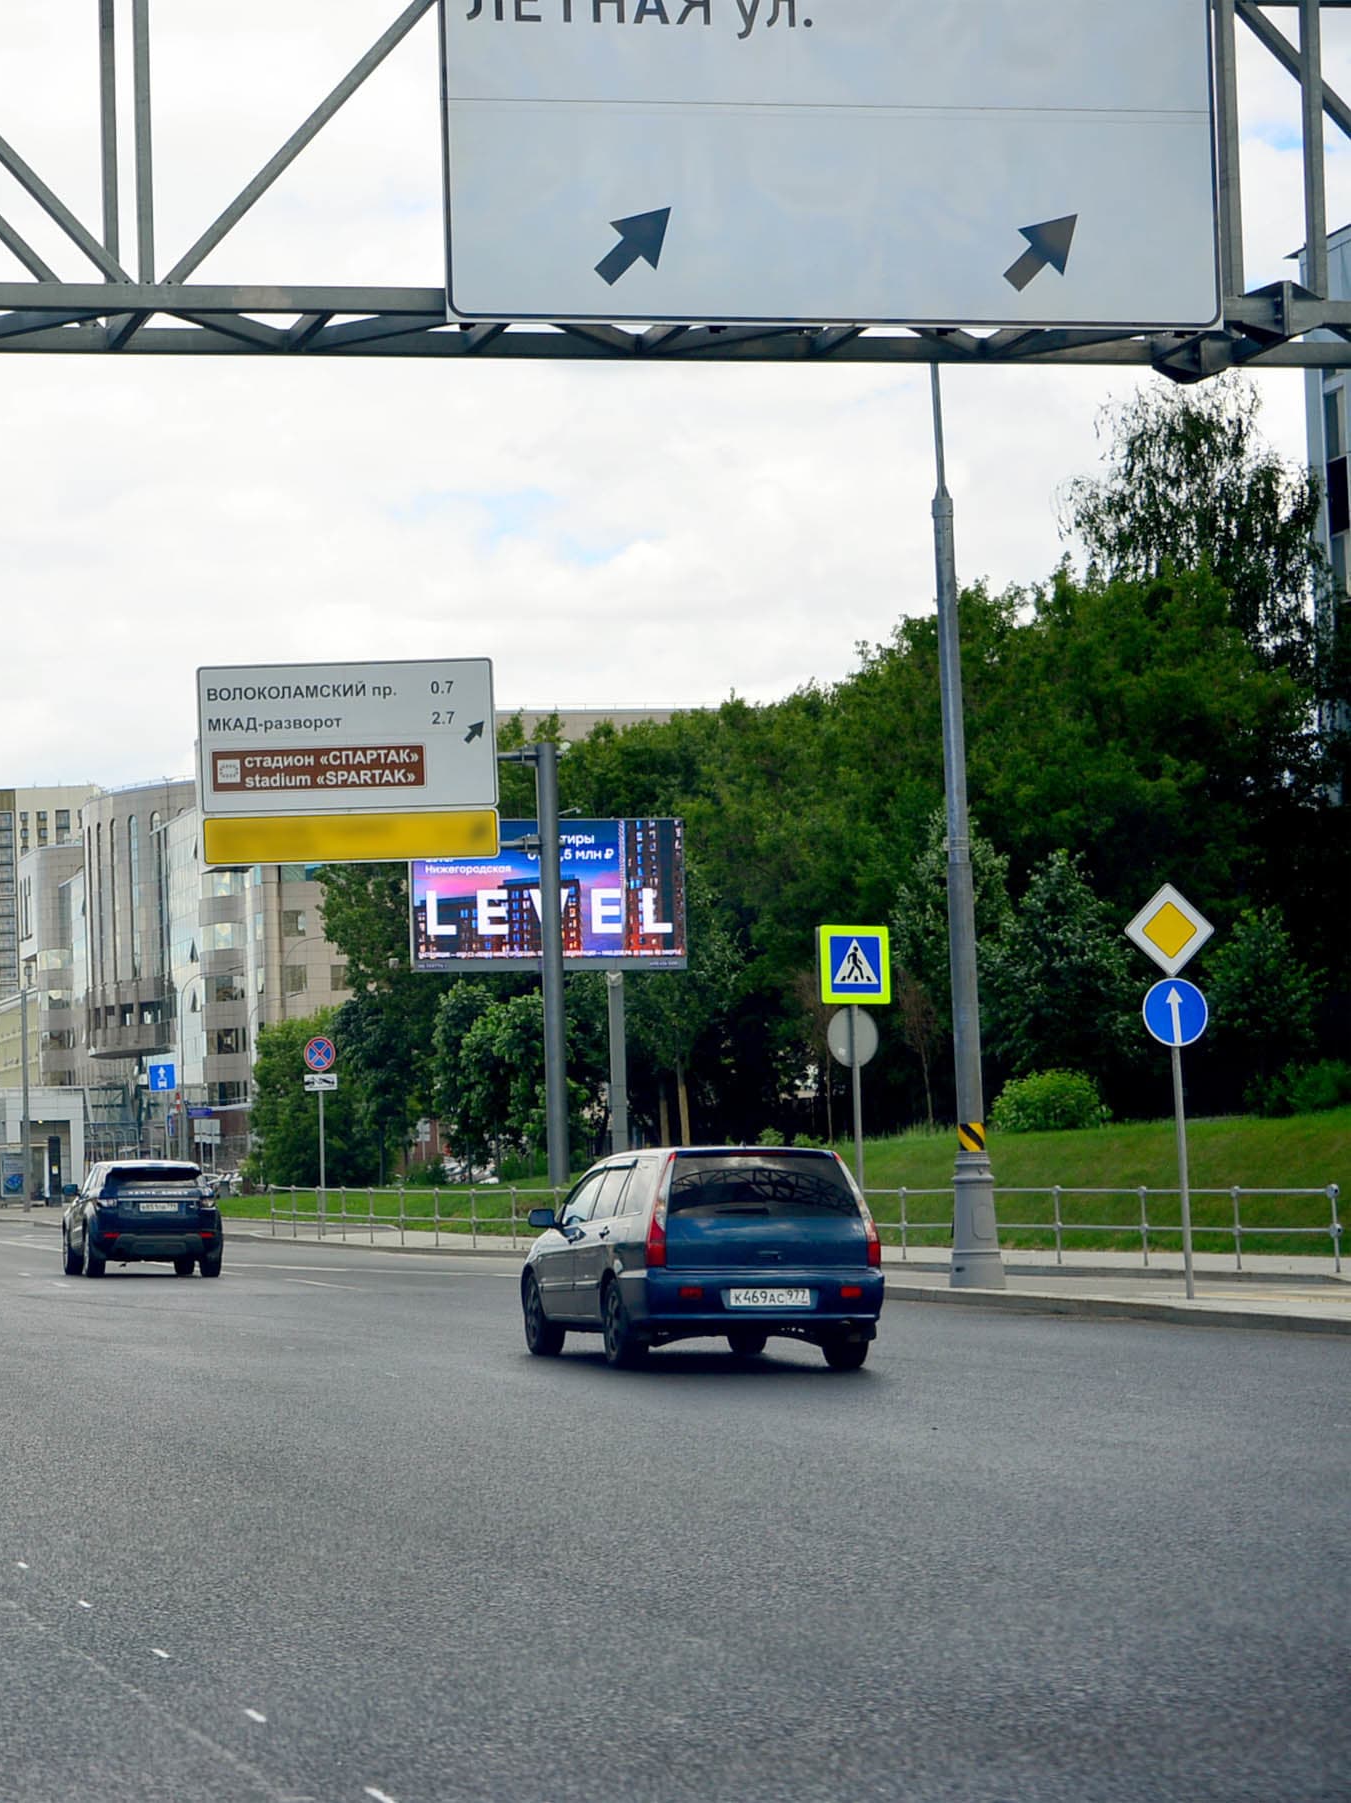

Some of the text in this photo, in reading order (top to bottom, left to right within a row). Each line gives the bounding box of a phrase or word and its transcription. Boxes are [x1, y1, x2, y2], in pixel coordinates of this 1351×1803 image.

[736, 0, 813, 39] ул.
[207, 681, 454, 701] ВОЛОКОЛАМСКИЙ пр. 0.7
[208, 711, 455, 733] МКАД-разворот 2.7
[244, 749, 419, 769] стадион «СПАРТАК»
[245, 769, 416, 788] stadium «SPARTAK»
[575, 850, 602, 860] млн
